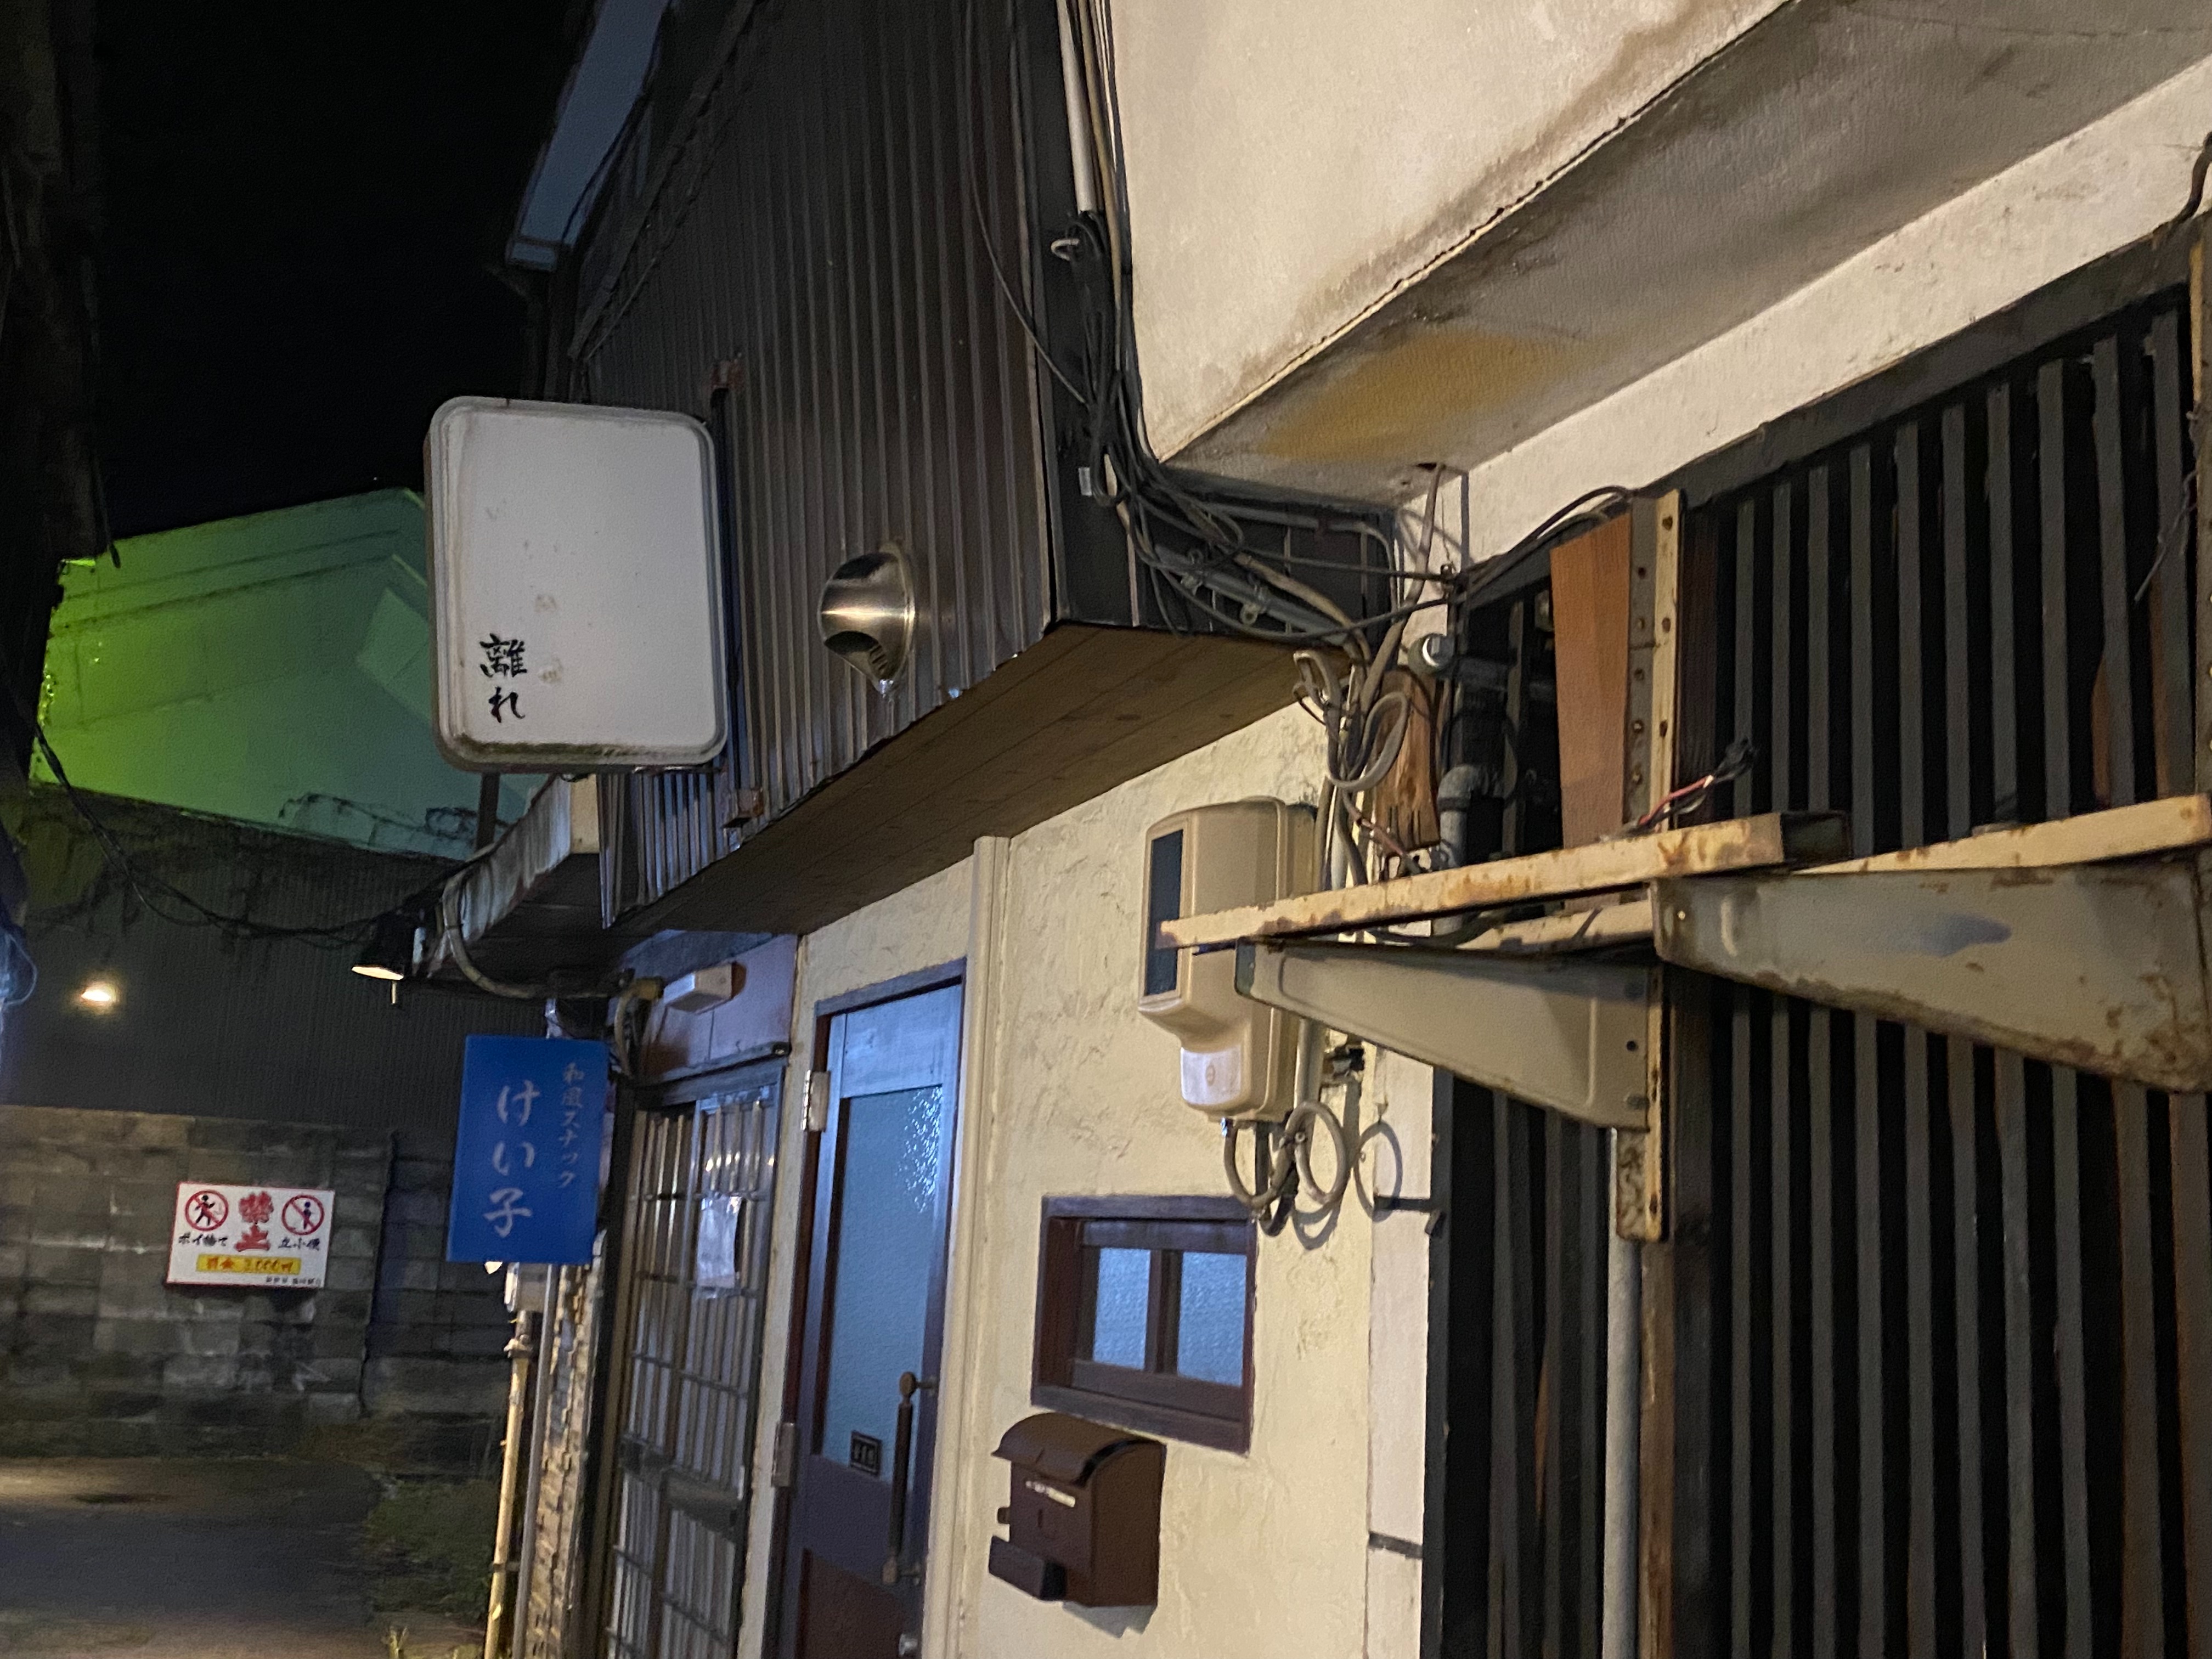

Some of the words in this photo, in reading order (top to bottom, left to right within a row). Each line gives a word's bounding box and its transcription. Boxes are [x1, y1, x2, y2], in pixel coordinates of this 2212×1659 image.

[479, 633, 527, 723] 離れ
[483, 1080, 540, 1238] けい子
[558, 1062, 585, 1189] 和風スナック
